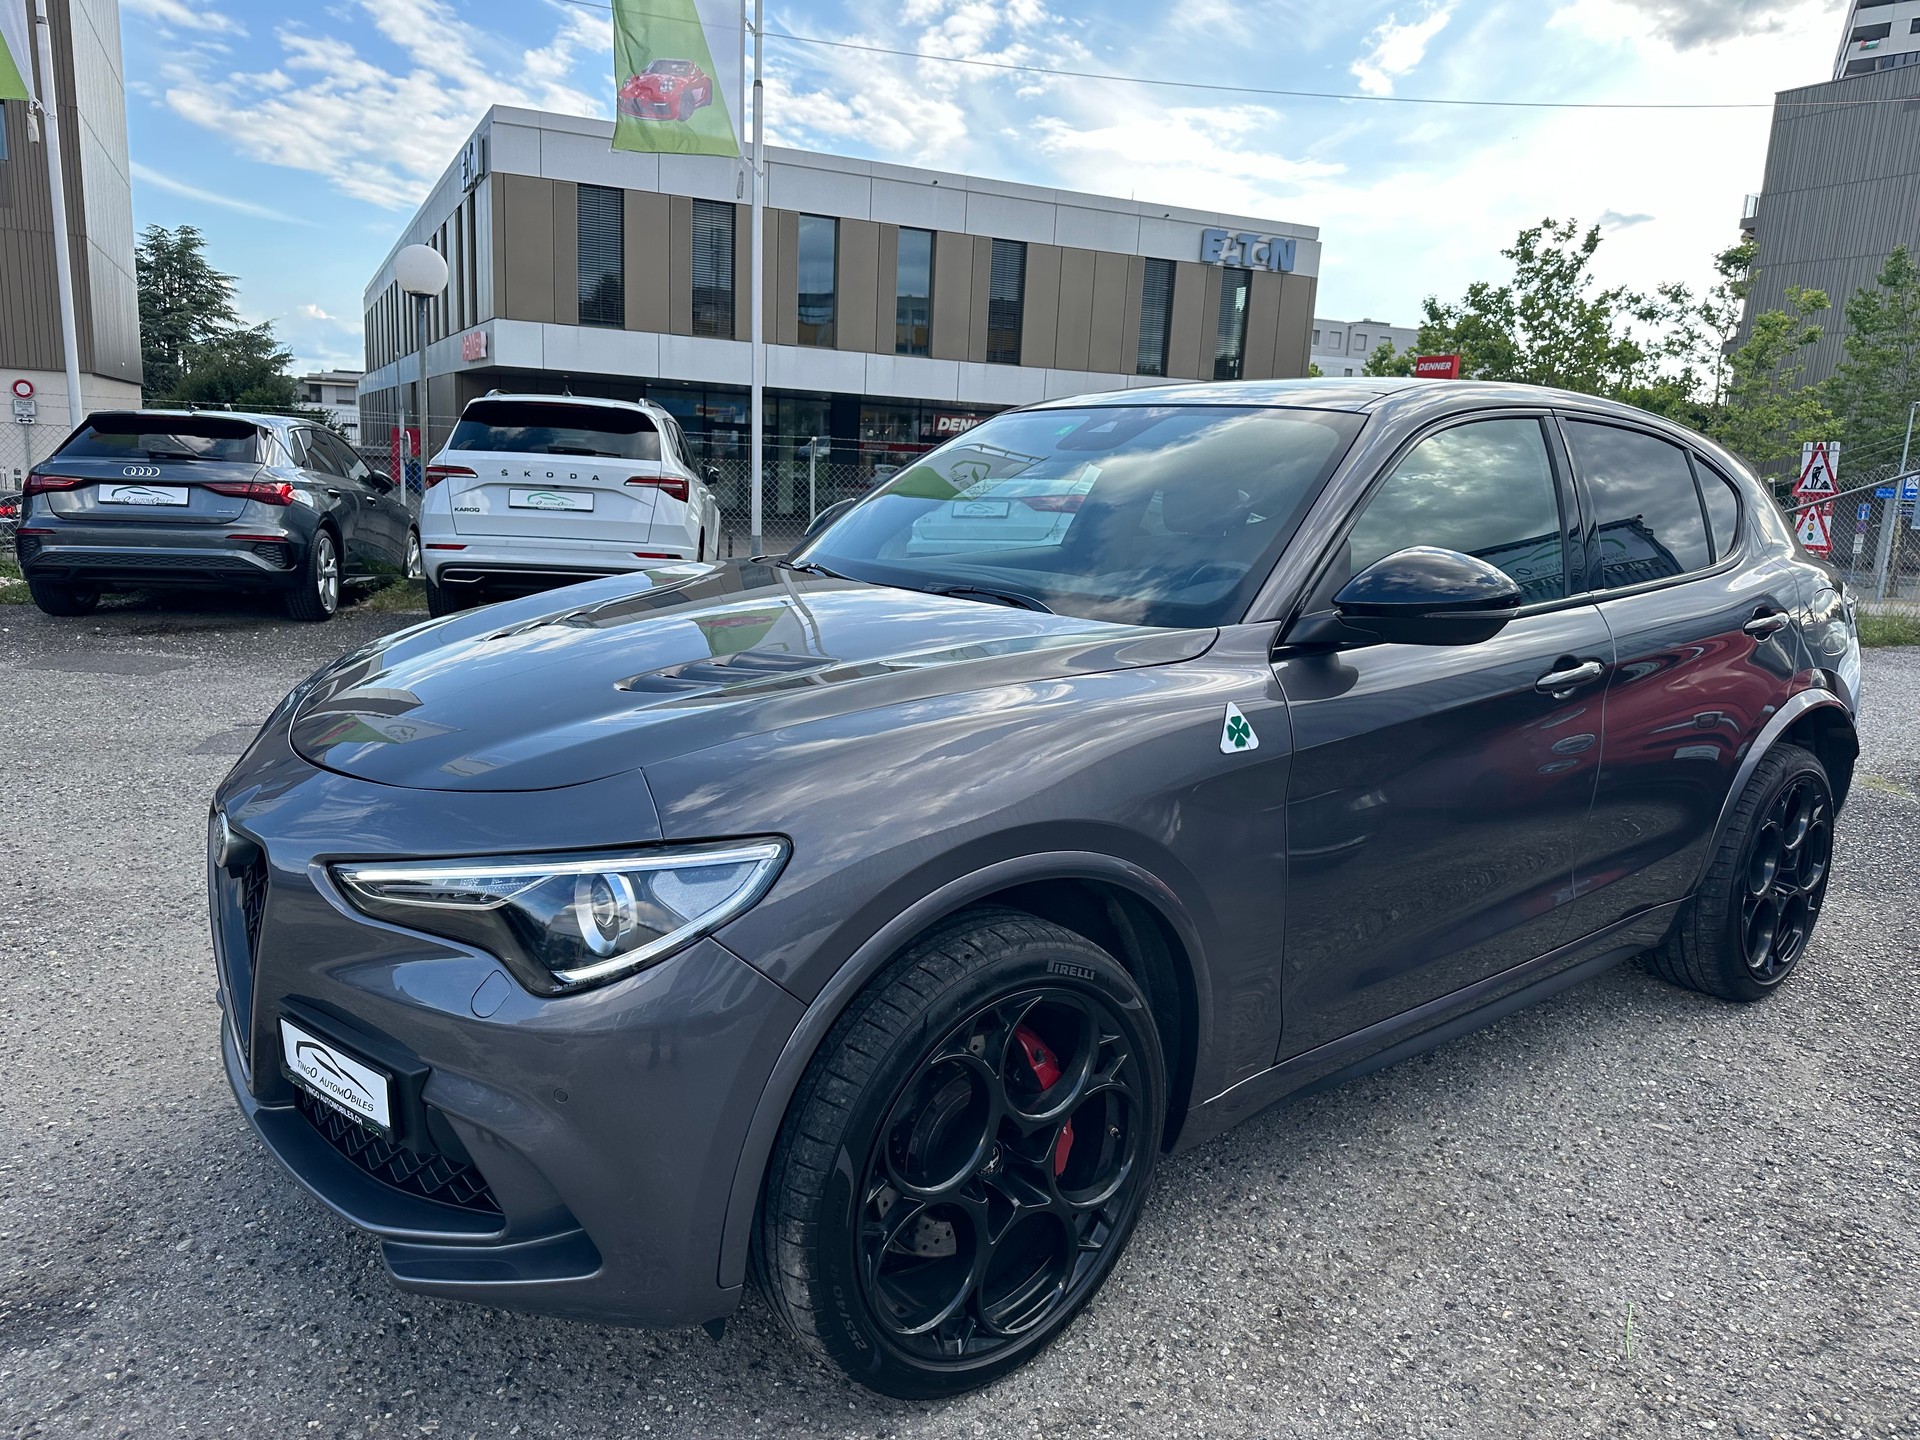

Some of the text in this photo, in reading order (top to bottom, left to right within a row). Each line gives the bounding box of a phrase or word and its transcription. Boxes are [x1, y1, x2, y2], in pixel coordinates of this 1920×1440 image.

[1201, 228, 1297, 273] EATON
[1418, 361, 1452, 371] DENNER
[1046, 959, 1096, 980] PIRELLI
[297, 1059, 374, 1112] TINGO AUTOMOBILES
